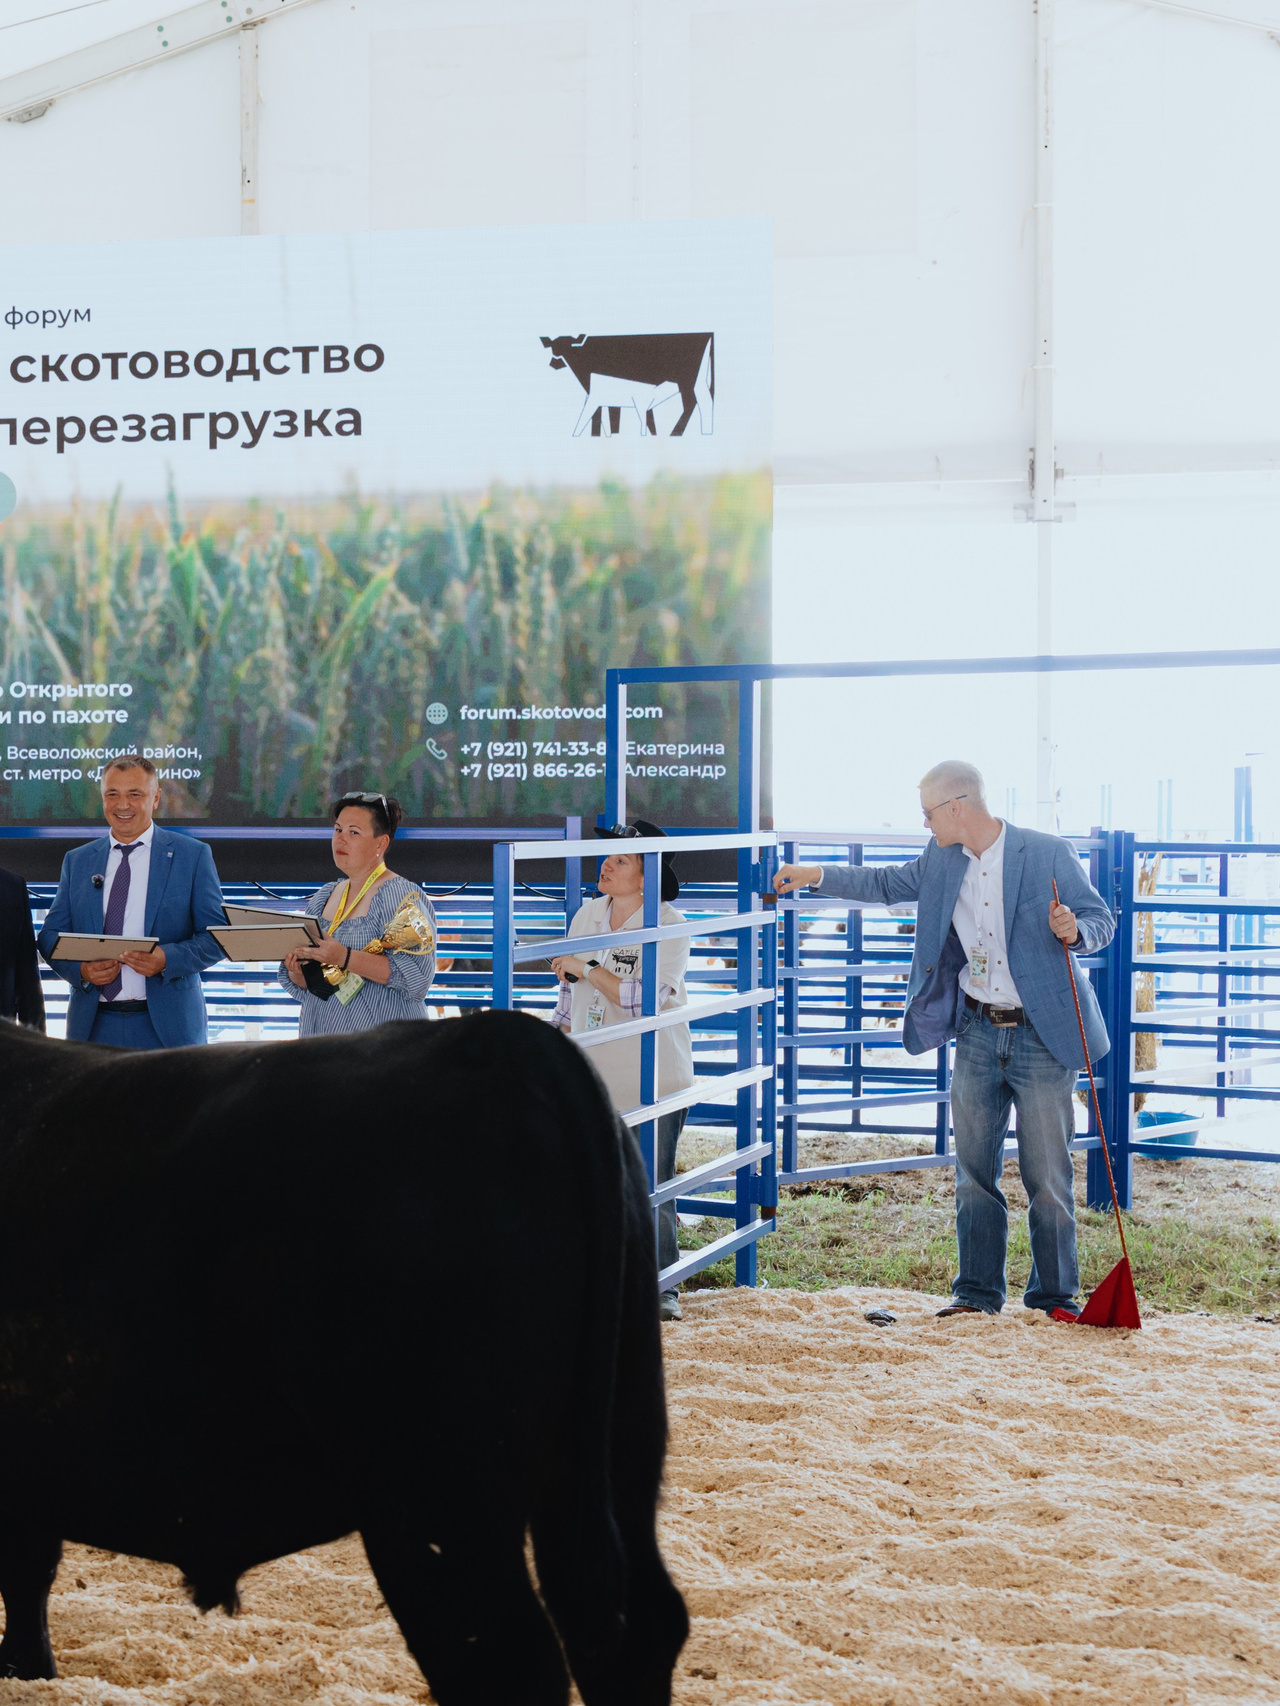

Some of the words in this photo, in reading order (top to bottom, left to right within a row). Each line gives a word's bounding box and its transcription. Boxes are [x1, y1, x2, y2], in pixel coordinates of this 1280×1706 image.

[4, 305, 92, 331] форум
[8, 342, 386, 384] скотоводство
[9, 681, 133, 702] Открытого
[18, 710, 46, 724] по
[52, 709, 129, 724] пахоте
[460, 704, 664, 720] forum.skotovodcom
[7, 744, 138, 760] Всеволожский
[142, 743, 203, 760] район,
[460, 742, 482, 757] +7
[487, 741, 528, 760] (921)
[532, 741, 607, 757] 741-33-8
[625, 741, 726, 759] Екатерина
[2, 769, 24, 781] ст.
[28, 768, 83, 783] метро
[86, 766, 202, 782] «Дино»
[460, 763, 482, 778] +7
[487, 762, 528, 781] (921)
[532, 762, 607, 778] 866-26-1
[625, 762, 727, 780] Александр
